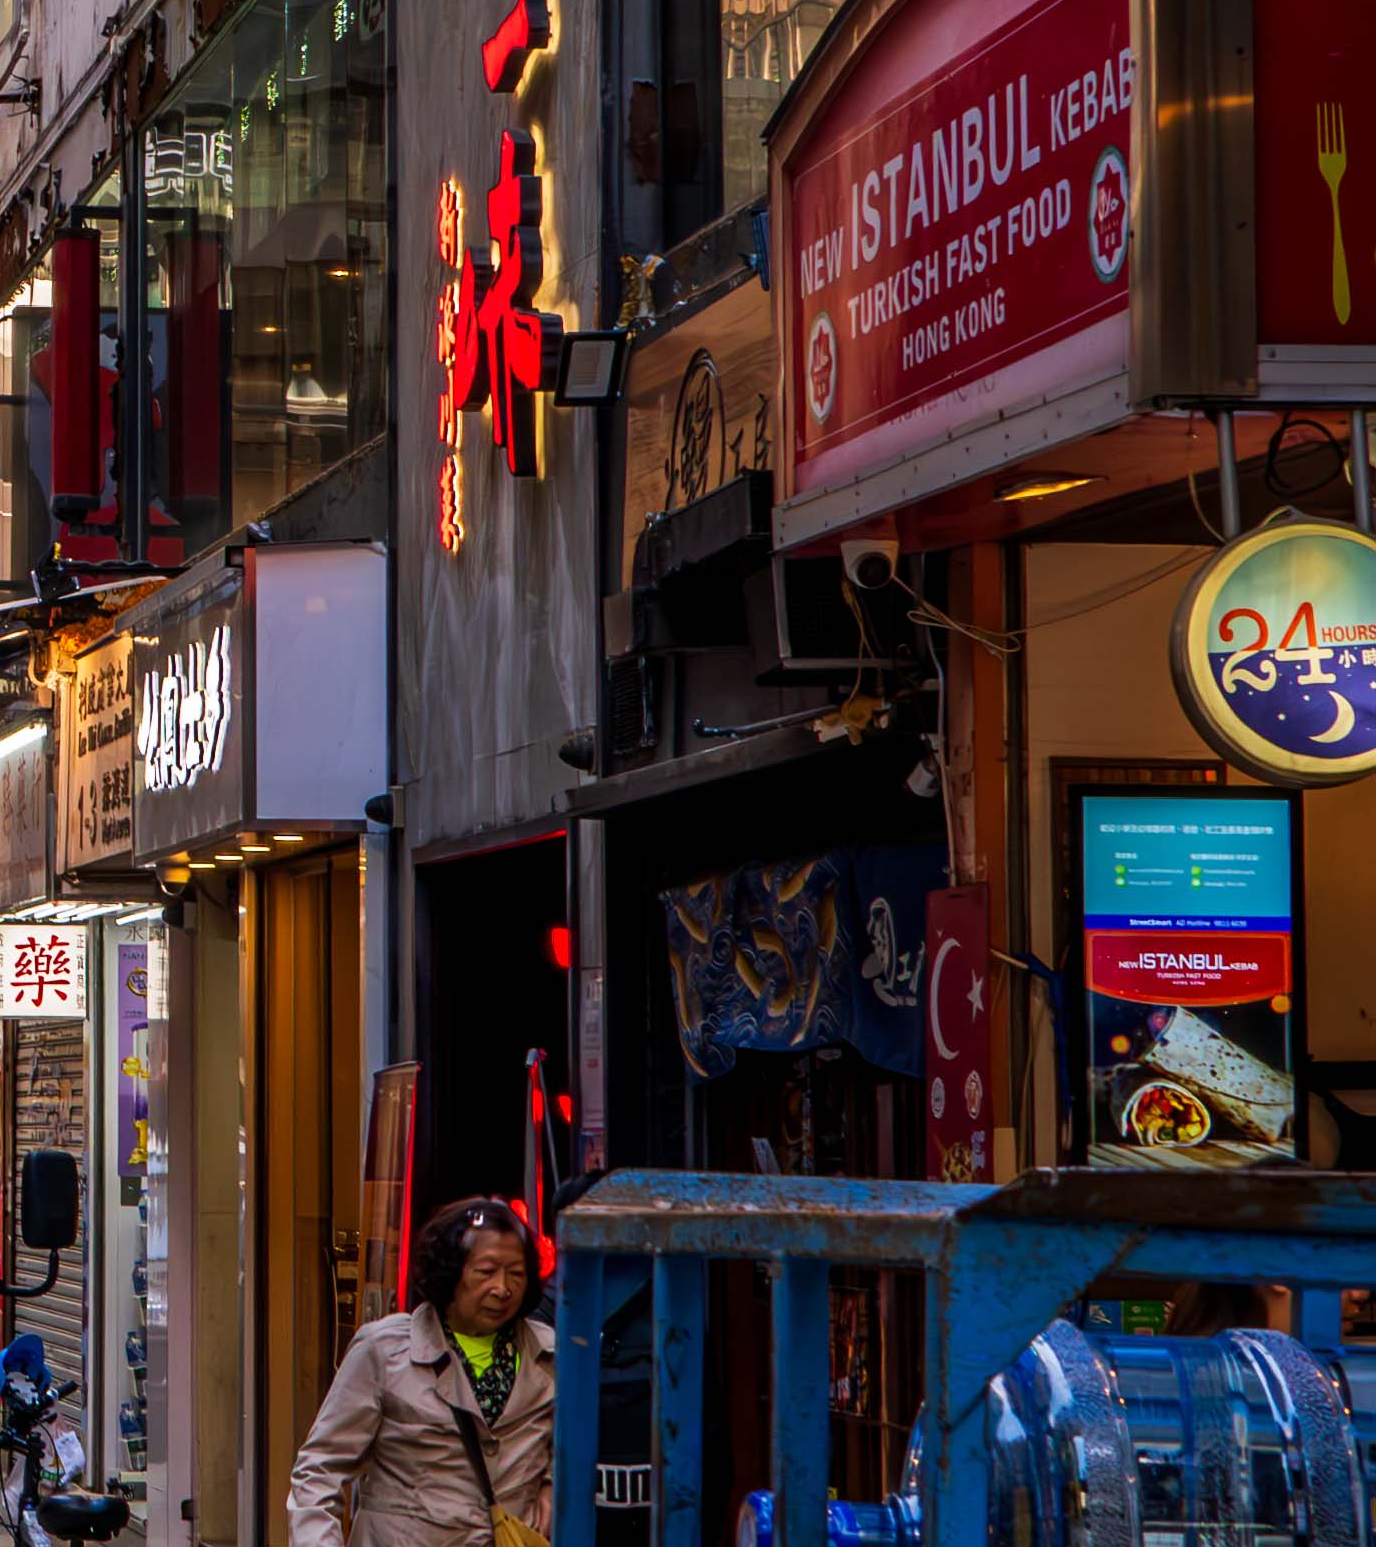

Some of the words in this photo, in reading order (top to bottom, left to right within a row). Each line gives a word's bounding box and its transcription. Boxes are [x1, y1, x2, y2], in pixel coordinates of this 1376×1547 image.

[801, 227, 844, 298] NEW
[851, 74, 1041, 271] ISTANBUL
[1051, 47, 1134, 151] KEBAB
[848, 251, 940, 339] TURKISH
[946, 216, 1002, 288] FAST
[1008, 179, 1070, 255] FOOD
[902, 315, 950, 371] HONG
[956, 288, 1005, 341] KONG
[1219, 601, 1336, 693] 24
[1321, 625, 1376, 642] HOURS
[10, 934, 70, 1007] 藥
[1118, 961, 1139, 969] NEW
[1139, 953, 1230, 970] ISTANBUL
